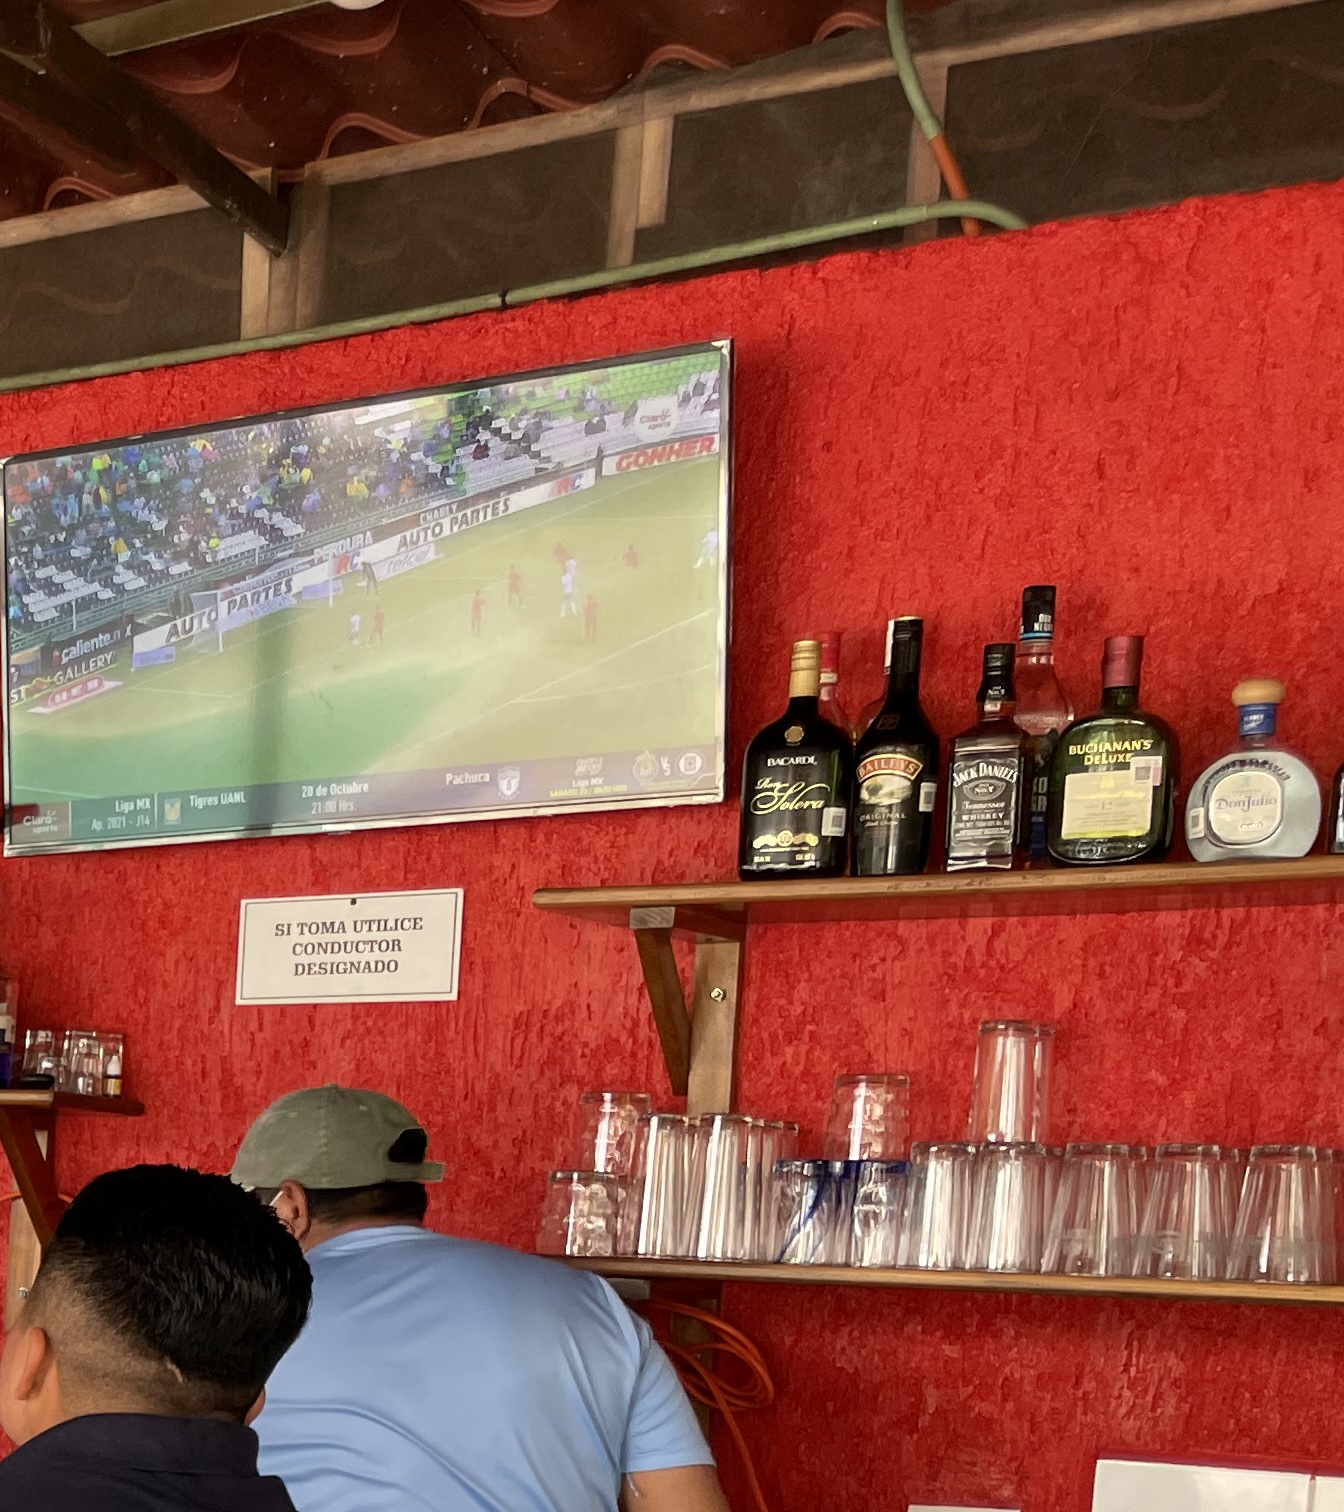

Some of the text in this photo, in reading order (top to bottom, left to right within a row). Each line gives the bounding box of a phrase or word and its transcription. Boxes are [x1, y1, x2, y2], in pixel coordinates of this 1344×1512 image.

[615, 435, 716, 473] GONHER
[397, 497, 512, 552] AUTO PARTES
[226, 577, 293, 616] PARTES
[54, 651, 113, 686] GALLERY
[1068, 739, 1153, 756] BUCHANAN'S
[857, 756, 920, 779] BAILEYS
[952, 766, 979, 788] JACK
[316, 783, 328, 796] de
[330, 781, 369, 796] Octubre
[446, 772, 490, 786] Pachuca
[115, 798, 151, 814] Liga MX
[189, 794, 218, 809] Tigres
[750, 781, 831, 815] Solera
[274, 916, 423, 937] SI TOMA UTILICE
[291, 938, 403, 957] CONDUCTOR
[293, 959, 399, 977] DESIGNADO
